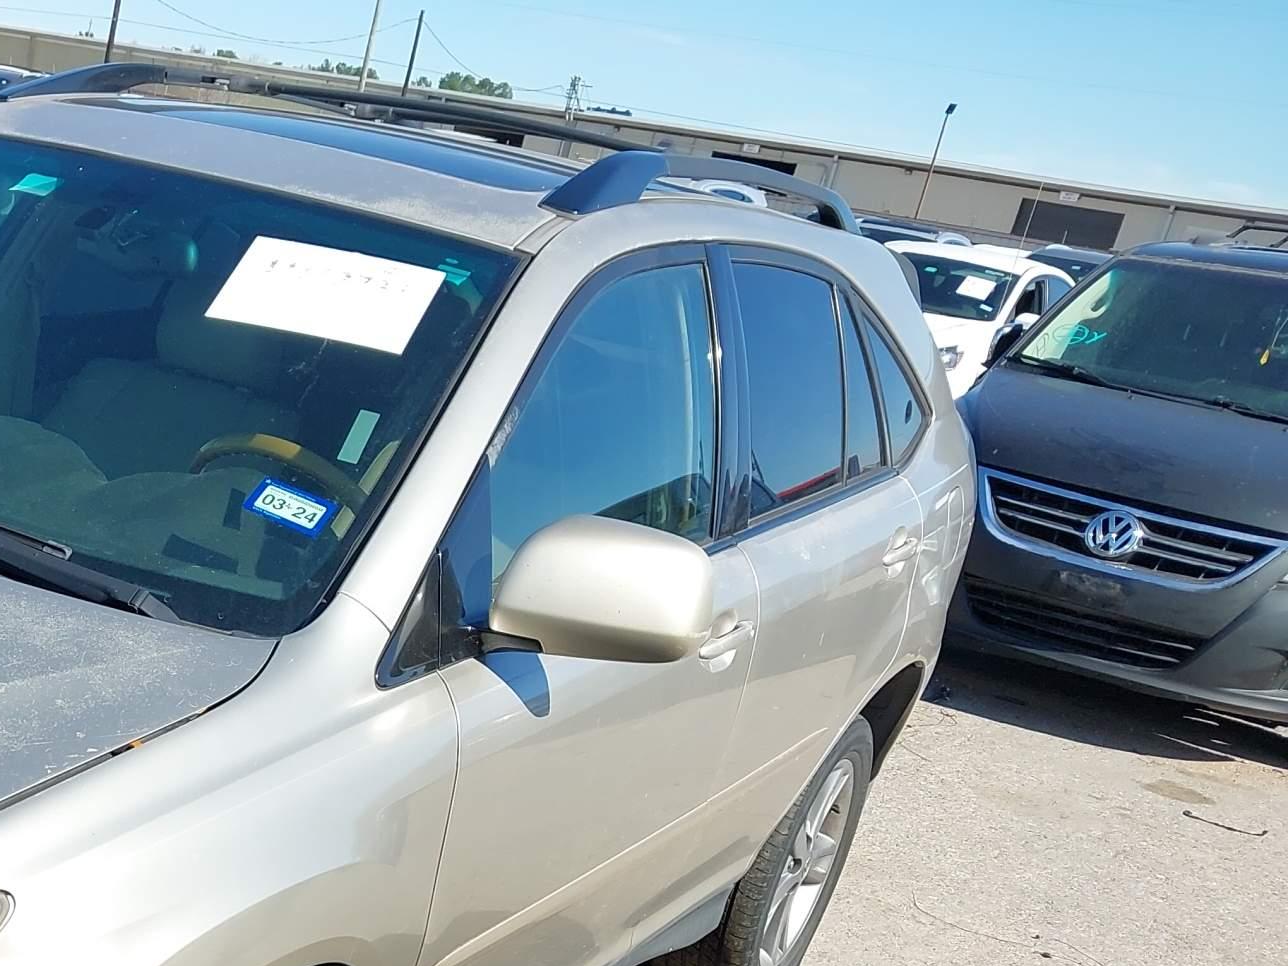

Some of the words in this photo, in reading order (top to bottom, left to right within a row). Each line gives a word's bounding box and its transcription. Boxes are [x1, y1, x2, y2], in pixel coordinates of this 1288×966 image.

[261, 493, 287, 510] 03
[291, 506, 318, 523] 24
[1086, 511, 1140, 557] VW
